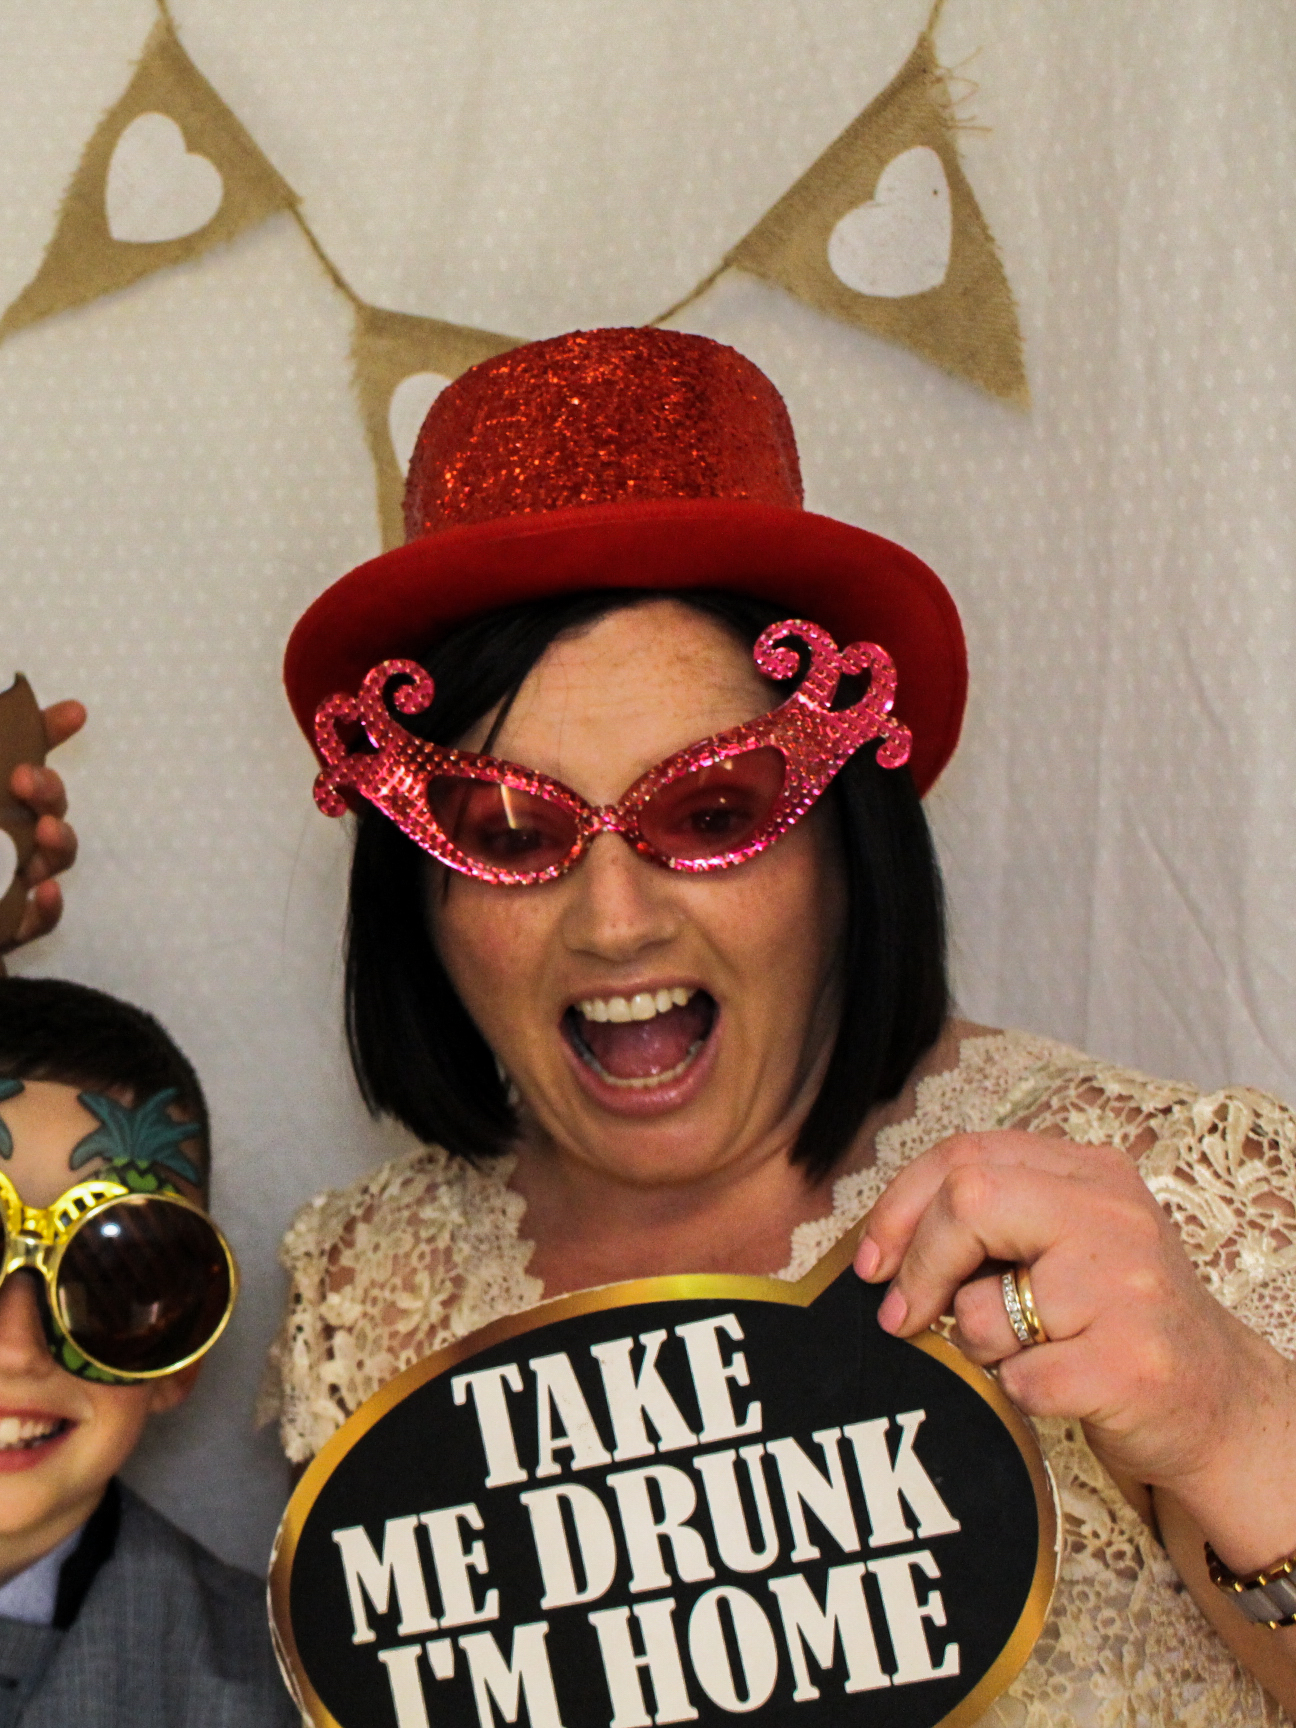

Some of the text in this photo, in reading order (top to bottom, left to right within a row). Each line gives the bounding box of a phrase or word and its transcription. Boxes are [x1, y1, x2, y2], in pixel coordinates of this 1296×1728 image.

[451, 1313, 763, 1489] TAKE
[332, 1409, 961, 1645] ME DRUNK
[378, 1549, 961, 1728] I'M HOME
